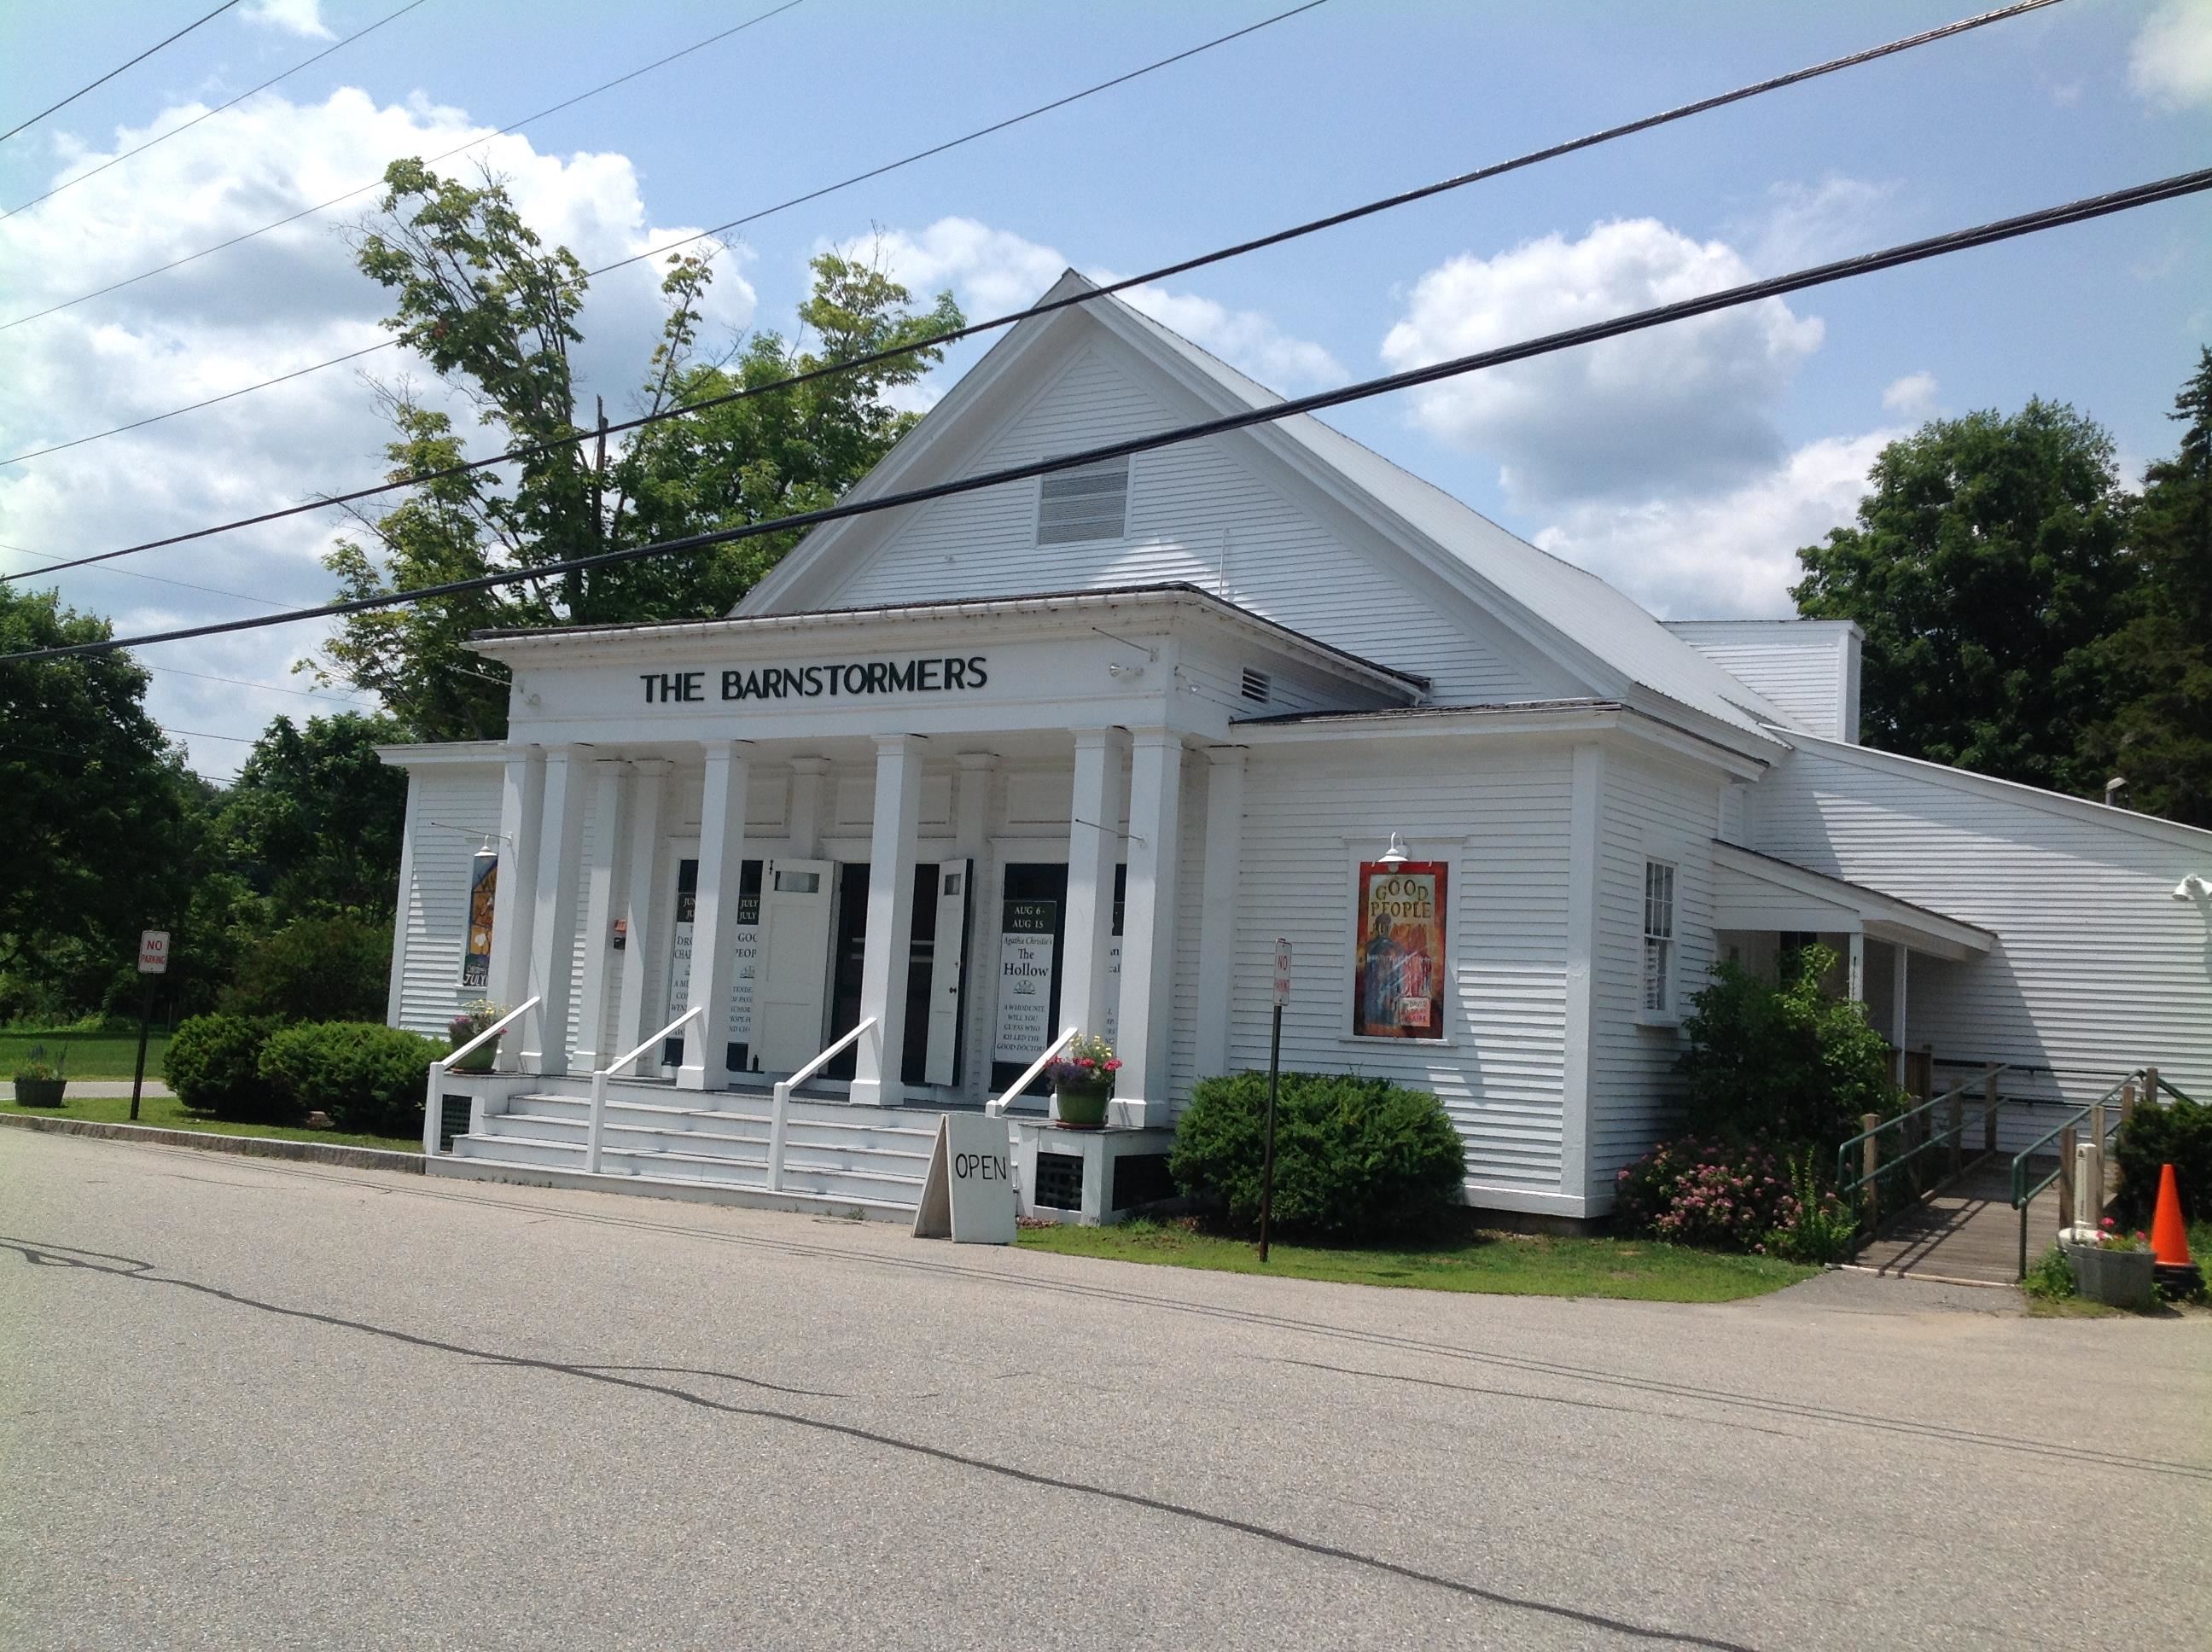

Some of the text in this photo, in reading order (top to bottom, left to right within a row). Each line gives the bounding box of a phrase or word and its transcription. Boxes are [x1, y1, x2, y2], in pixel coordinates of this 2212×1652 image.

[640, 656, 988, 702] THE BARNSTORMERS
[1376, 879, 1429, 901] GOOD
[741, 899, 759, 910] JULY
[1015, 906, 1033, 915] AUG
[1371, 901, 1431, 918] PEOPLE
[739, 911, 758, 922] JULY
[1012, 919, 1044, 929] AUG 15
[147, 940, 163, 951] NO
[1018, 948, 1034, 960] The
[1278, 955, 1288, 971] NO
[1004, 963, 1050, 977] Hollow
[463, 973, 486, 986] JULY
[955, 1153, 1007, 1181] OPEN
